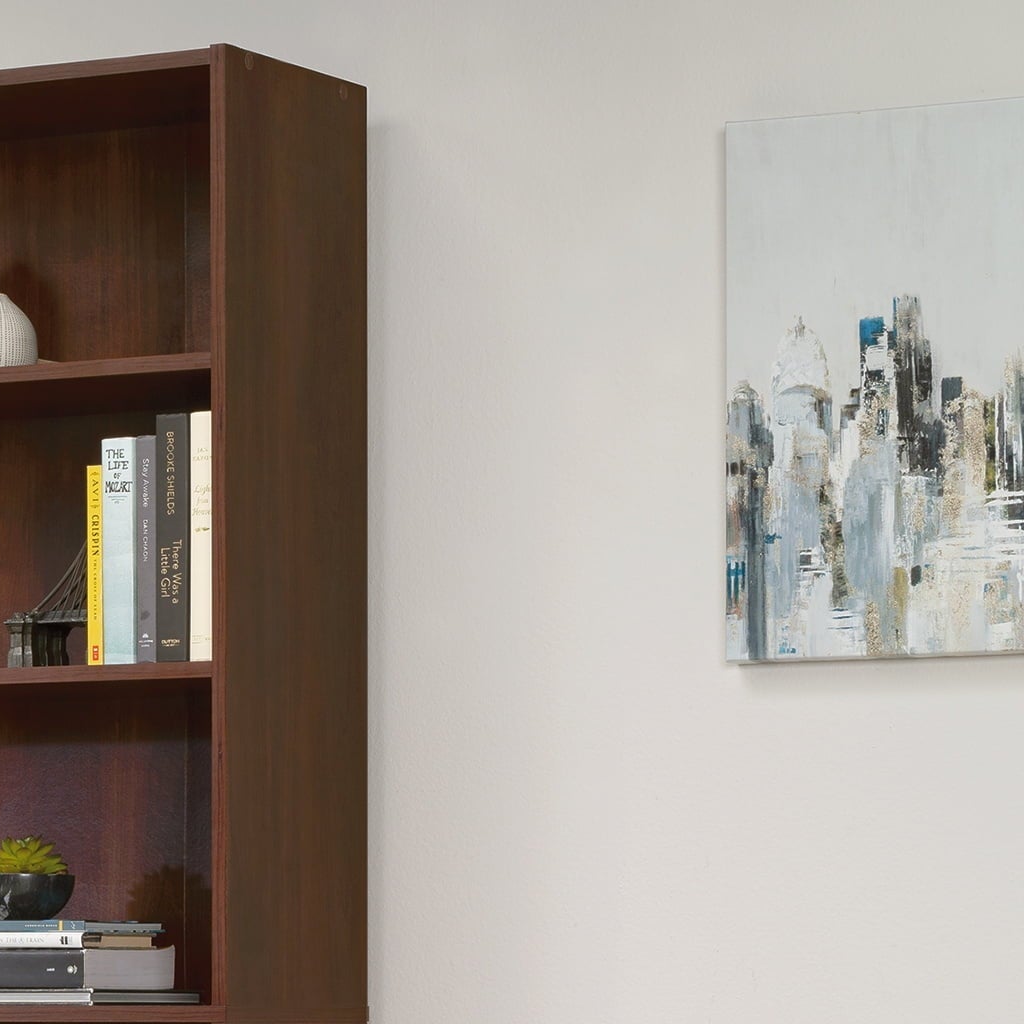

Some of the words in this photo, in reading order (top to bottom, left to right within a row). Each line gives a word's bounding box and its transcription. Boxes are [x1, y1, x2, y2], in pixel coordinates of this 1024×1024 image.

[105, 449, 125, 459] THE
[166, 431, 175, 473] BROOKE
[107, 460, 129, 471] LIFE
[113, 472, 122, 480] OF
[141, 458, 150, 478] Stay
[104, 481, 133, 493] MOZART
[142, 479, 150, 508] Awake
[166, 475, 175, 516] SHIELDS
[91, 514, 100, 556] CRISPIN
[160, 547, 171, 575] Little
[172, 539, 183, 570] There
[160, 577, 171, 598] Girl
[172, 572, 182, 595] Was
